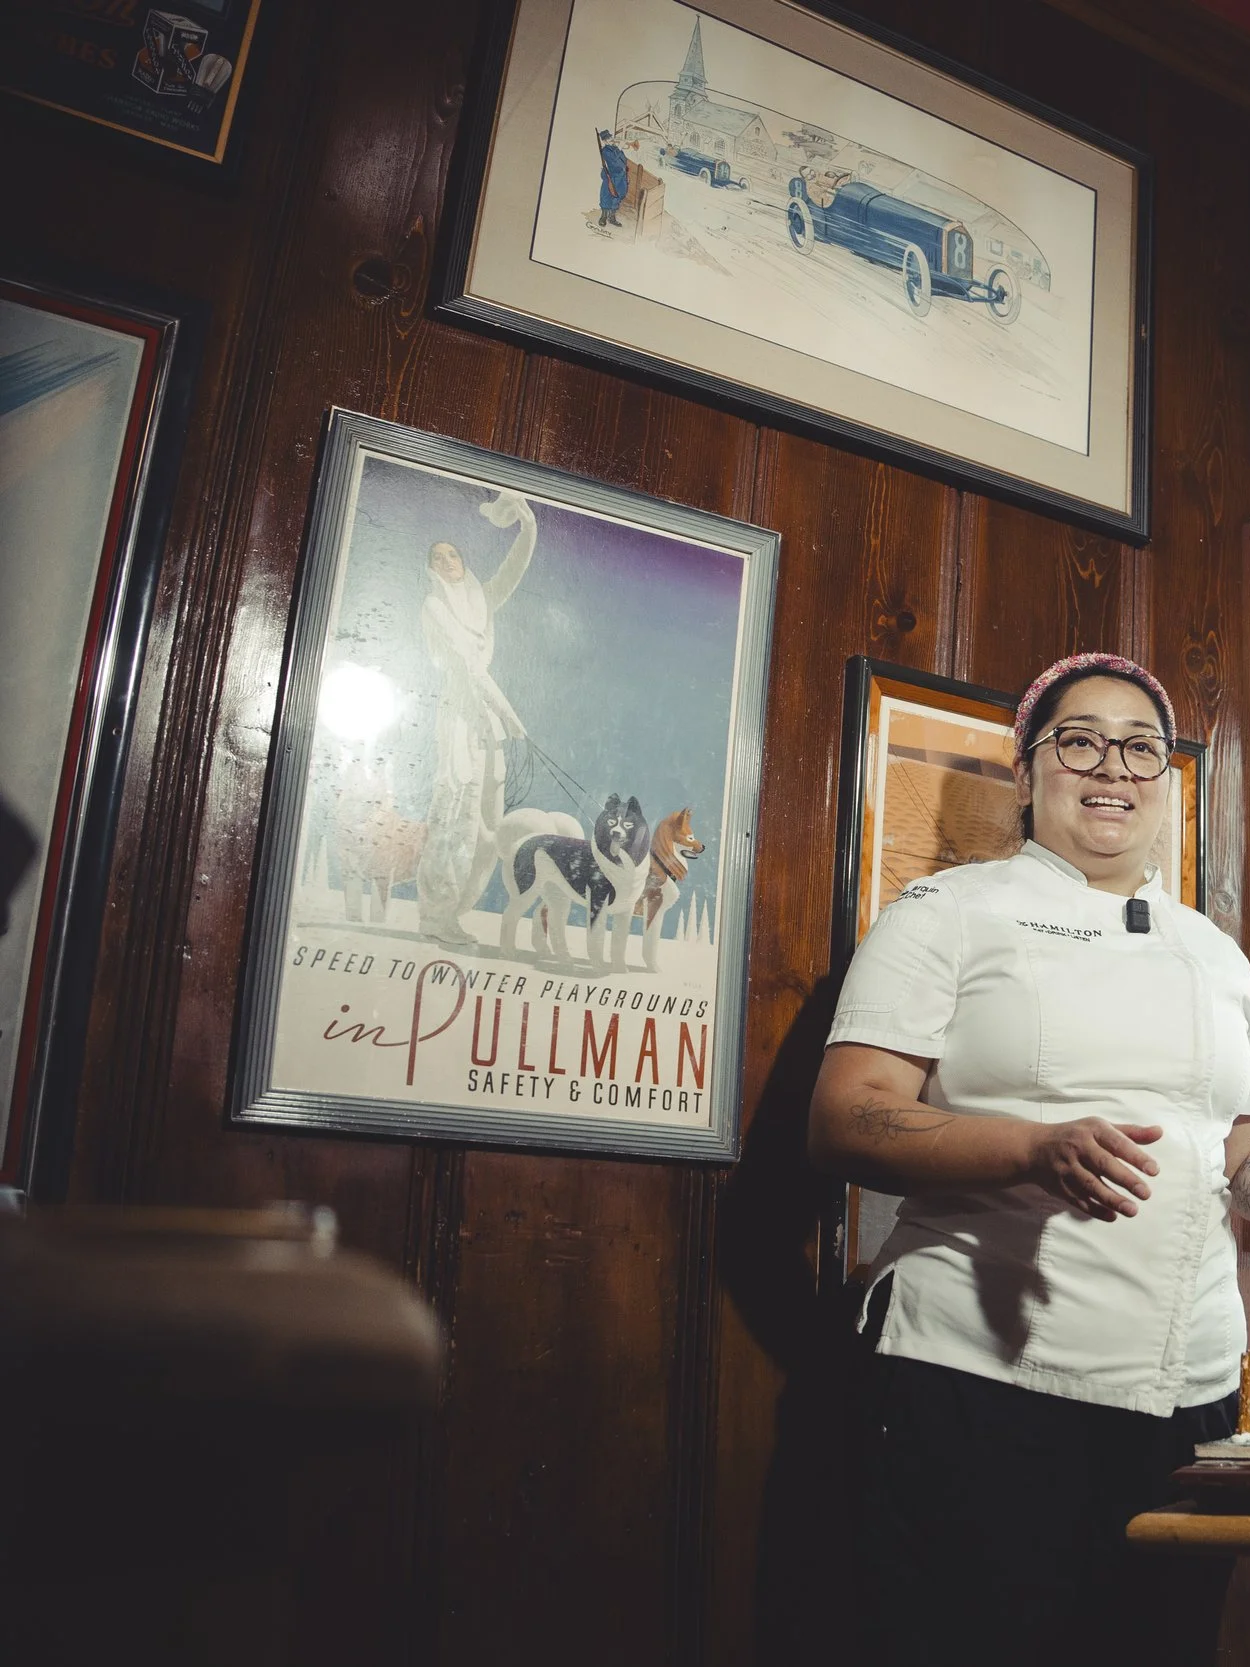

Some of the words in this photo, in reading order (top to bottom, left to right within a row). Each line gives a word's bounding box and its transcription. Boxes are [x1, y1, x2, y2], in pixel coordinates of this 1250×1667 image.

[954, 232, 968, 270] 8
[1029, 921, 1103, 938] HAMILTON
[292, 945, 376, 976] SPEED
[388, 958, 417, 981] TO
[429, 963, 525, 996] WINTER
[540, 979, 709, 1020] PLAYGROUNDS
[322, 1003, 411, 1047] in
[405, 958, 709, 1090] PULLMAN
[467, 1068, 556, 1101] SAFETY
[569, 1080, 582, 1102] &
[592, 1082, 704, 1115] COMFORT
